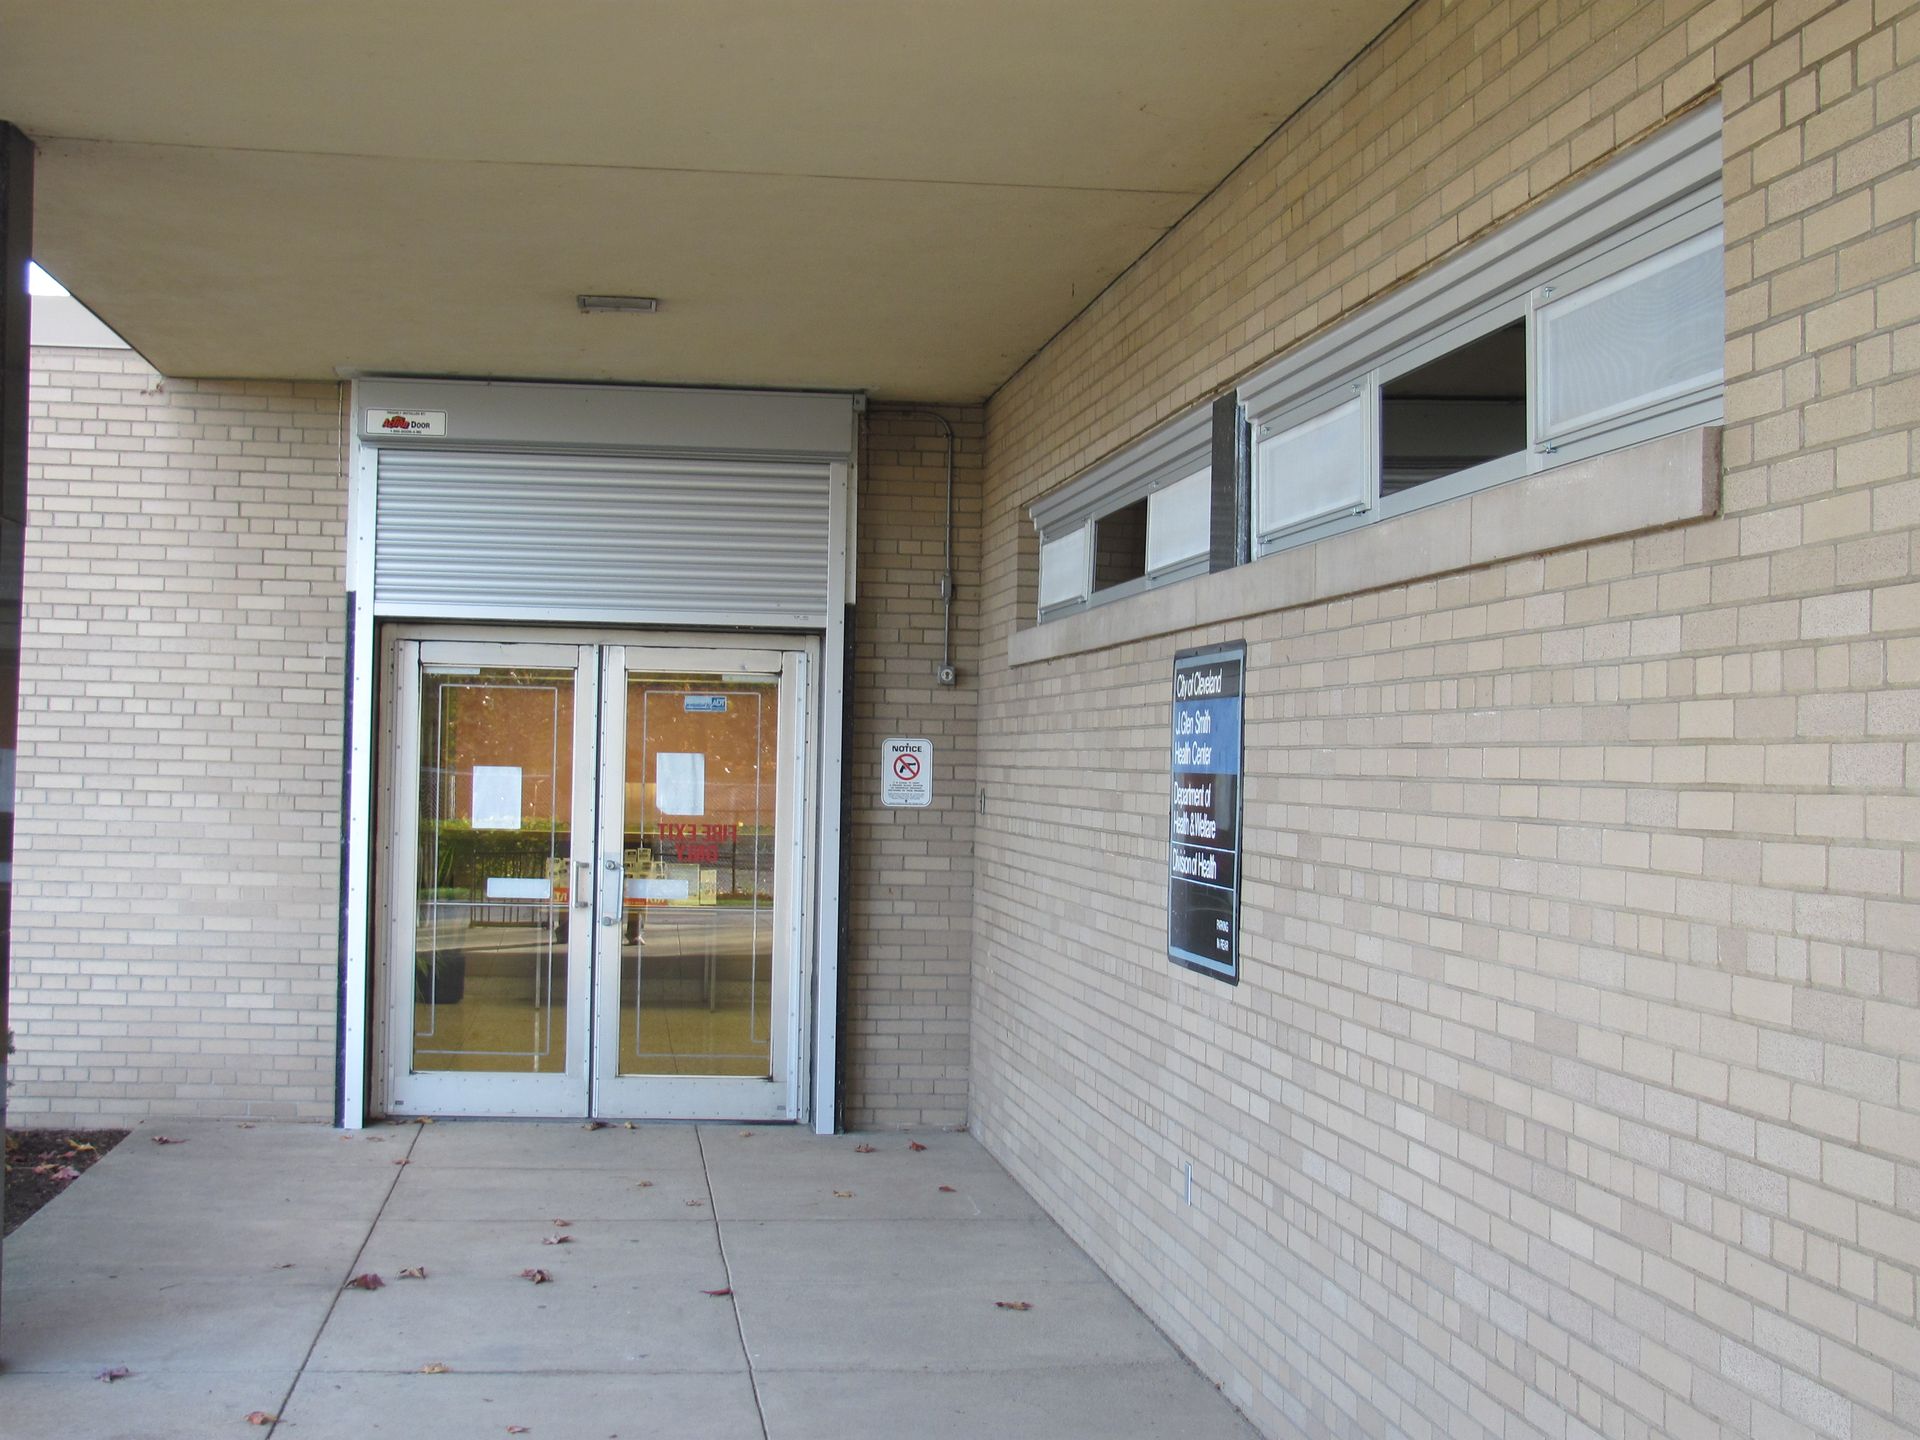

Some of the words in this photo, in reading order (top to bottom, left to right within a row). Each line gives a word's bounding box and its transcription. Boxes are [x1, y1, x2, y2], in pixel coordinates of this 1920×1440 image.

[1176, 672, 1188, 700] City
[1188, 672, 1195, 695] of
[1194, 668, 1222, 696] Cleveland
[1181, 710, 1194, 735] Glen
[1195, 709, 1211, 735] Smith
[1174, 741, 1191, 765] Health
[1191, 741, 1212, 766] Center
[1173, 781, 1204, 809] Department
[1204, 783, 1212, 808] of
[1173, 810, 1189, 836] Health
[1189, 812, 1195, 836] &
[1194, 812, 1216, 839] Welfare
[1172, 848, 1191, 874] Division
[1191, 852, 1198, 876] of
[1198, 852, 1217, 880] Health
